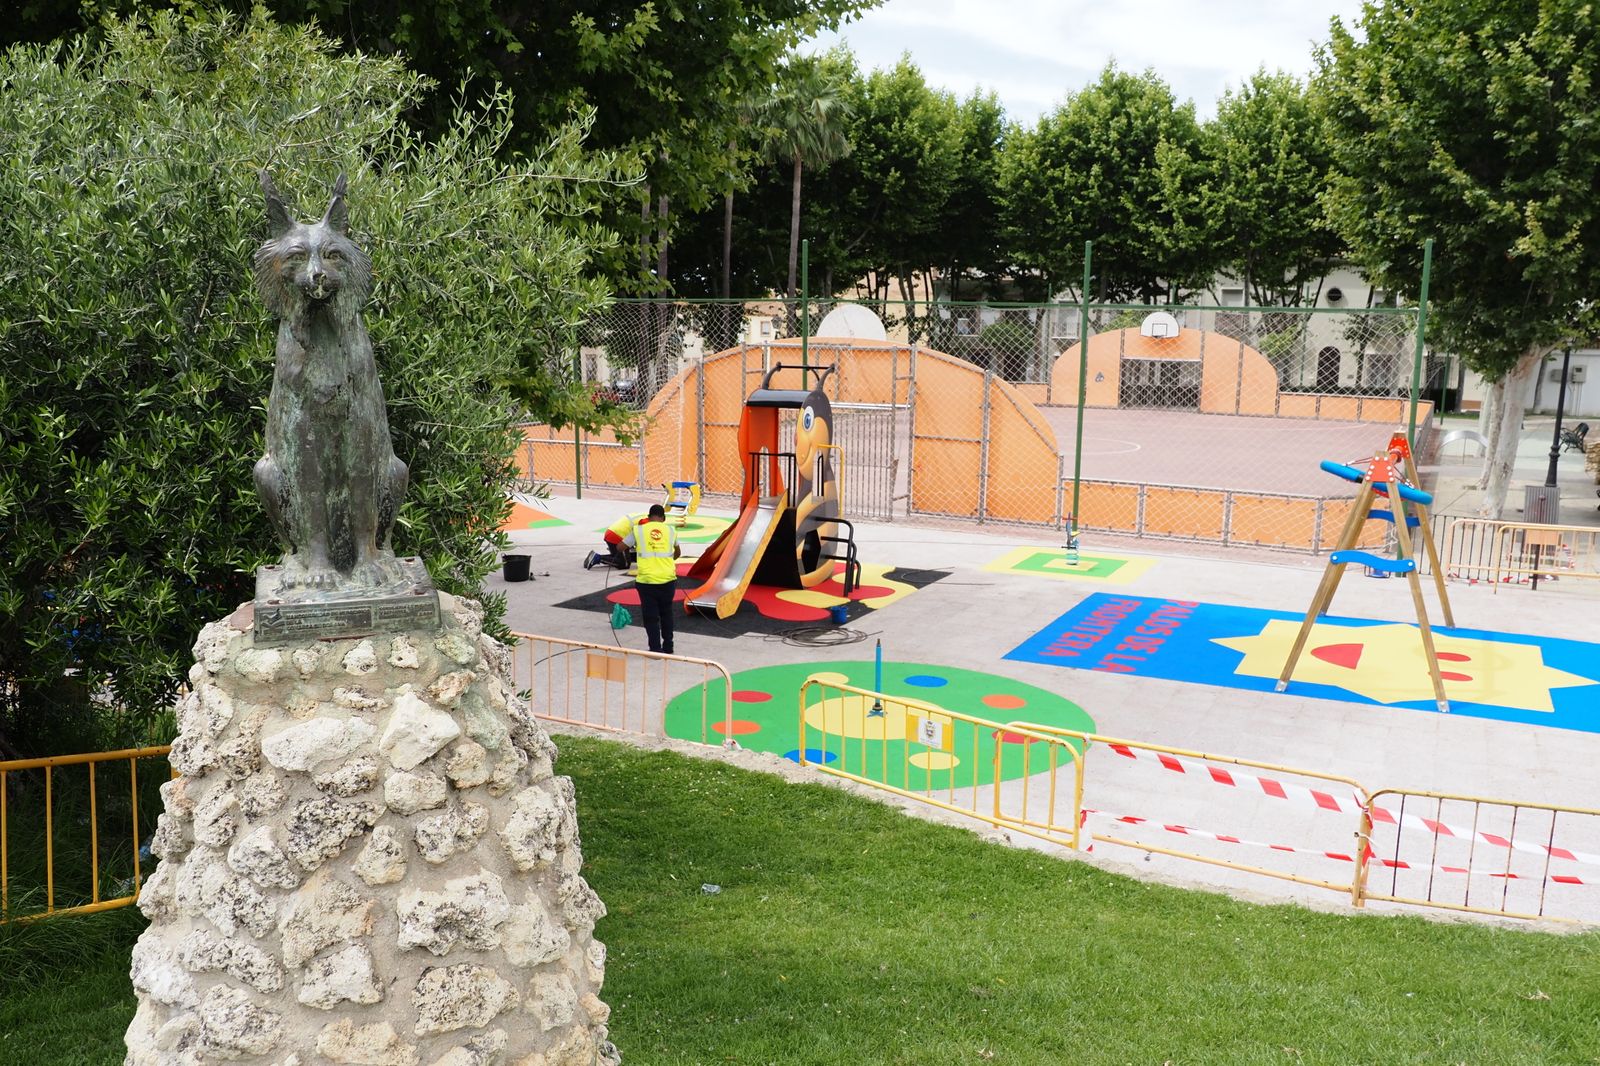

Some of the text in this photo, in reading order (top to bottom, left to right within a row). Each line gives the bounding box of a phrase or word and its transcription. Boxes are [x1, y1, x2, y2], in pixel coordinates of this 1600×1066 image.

[1038, 598, 1143, 657] FRONTERA
[1091, 599, 1200, 673] PALOS DE LA
